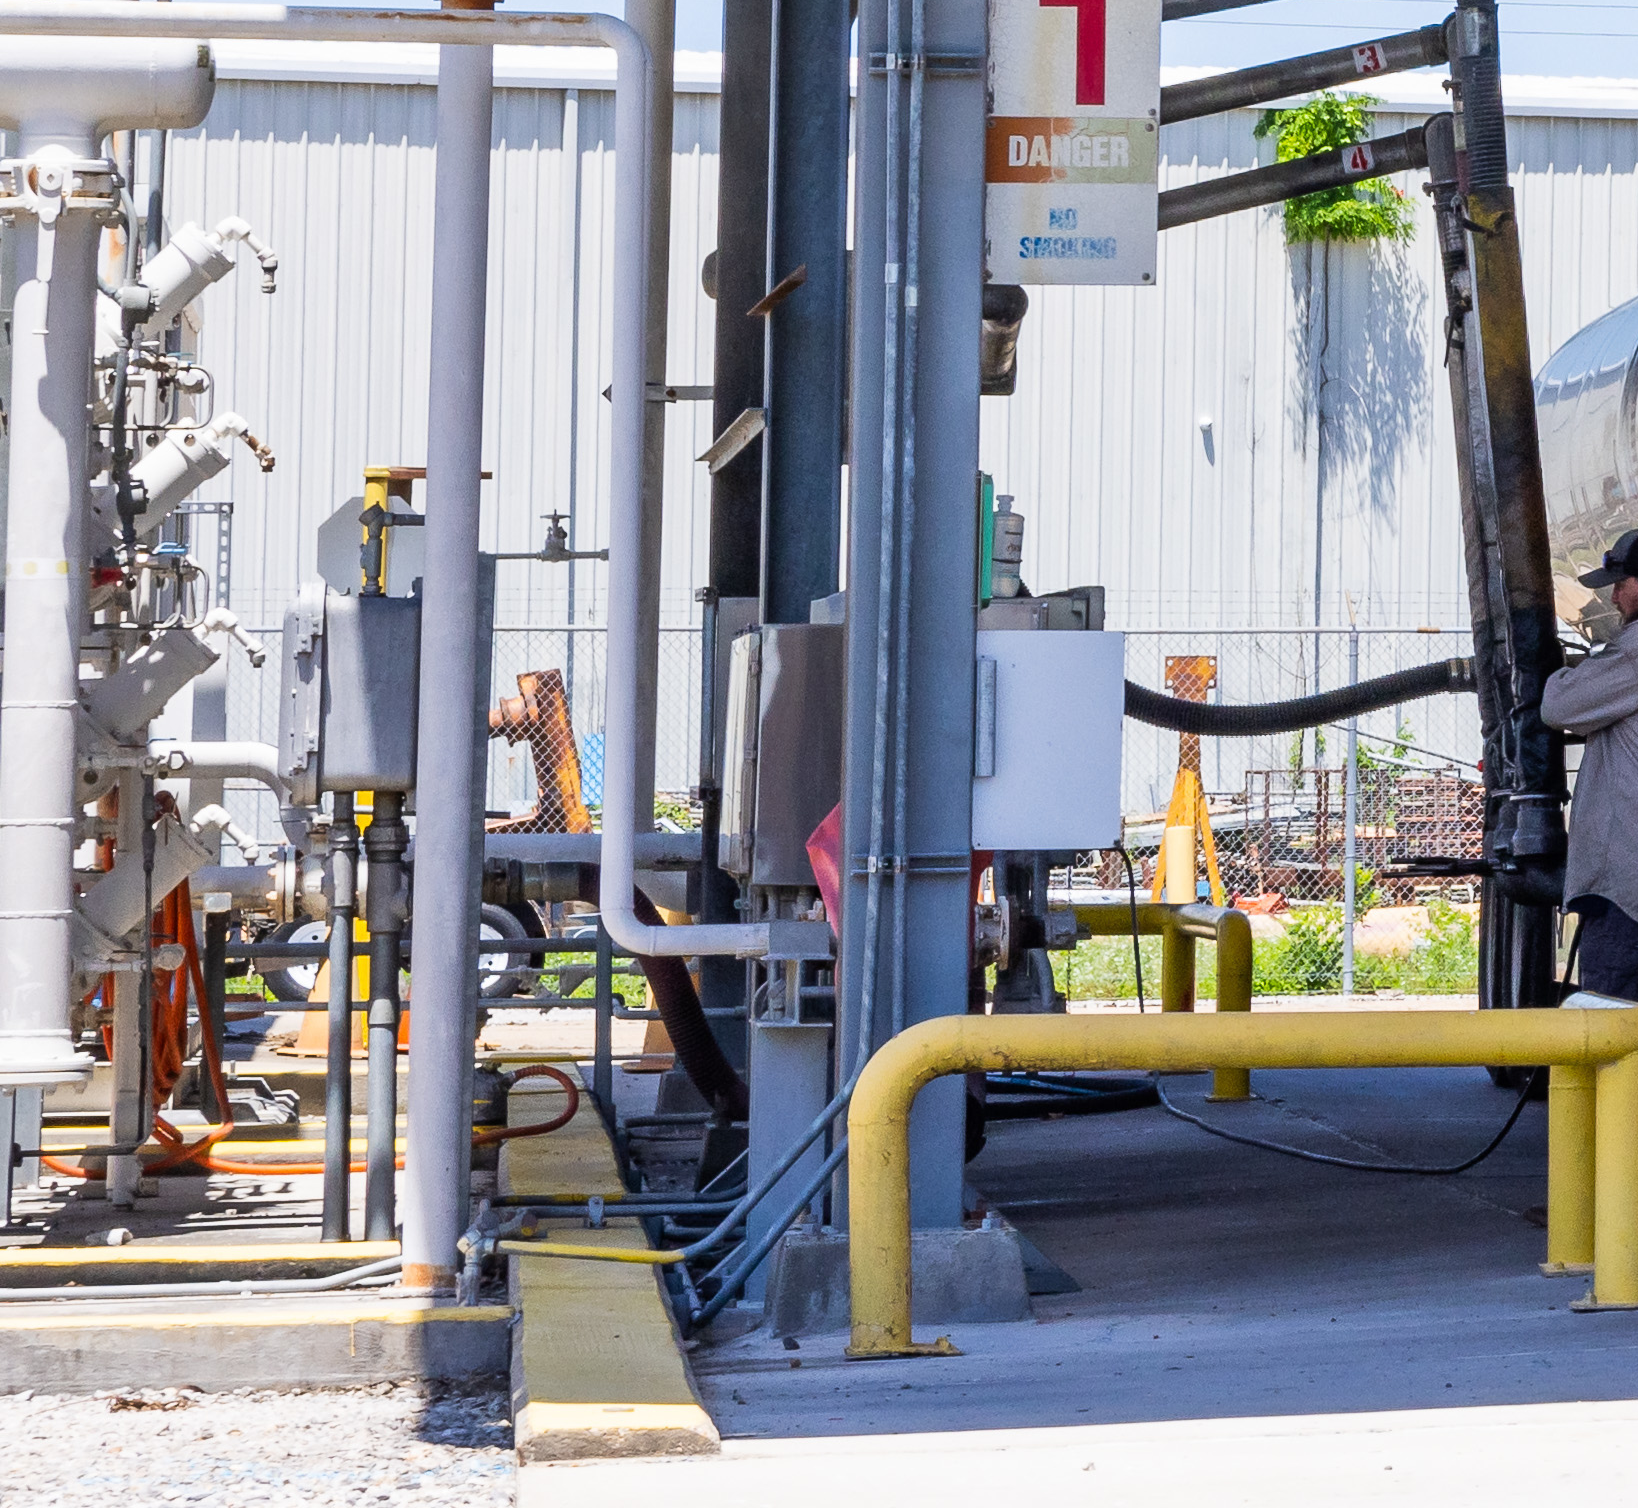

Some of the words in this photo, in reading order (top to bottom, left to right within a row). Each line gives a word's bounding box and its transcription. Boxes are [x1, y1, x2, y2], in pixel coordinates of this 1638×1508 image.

[1008, 135, 1129, 167] DANGER
[1049, 208, 1078, 230] NO
[1019, 237, 1117, 259] SMOKING
